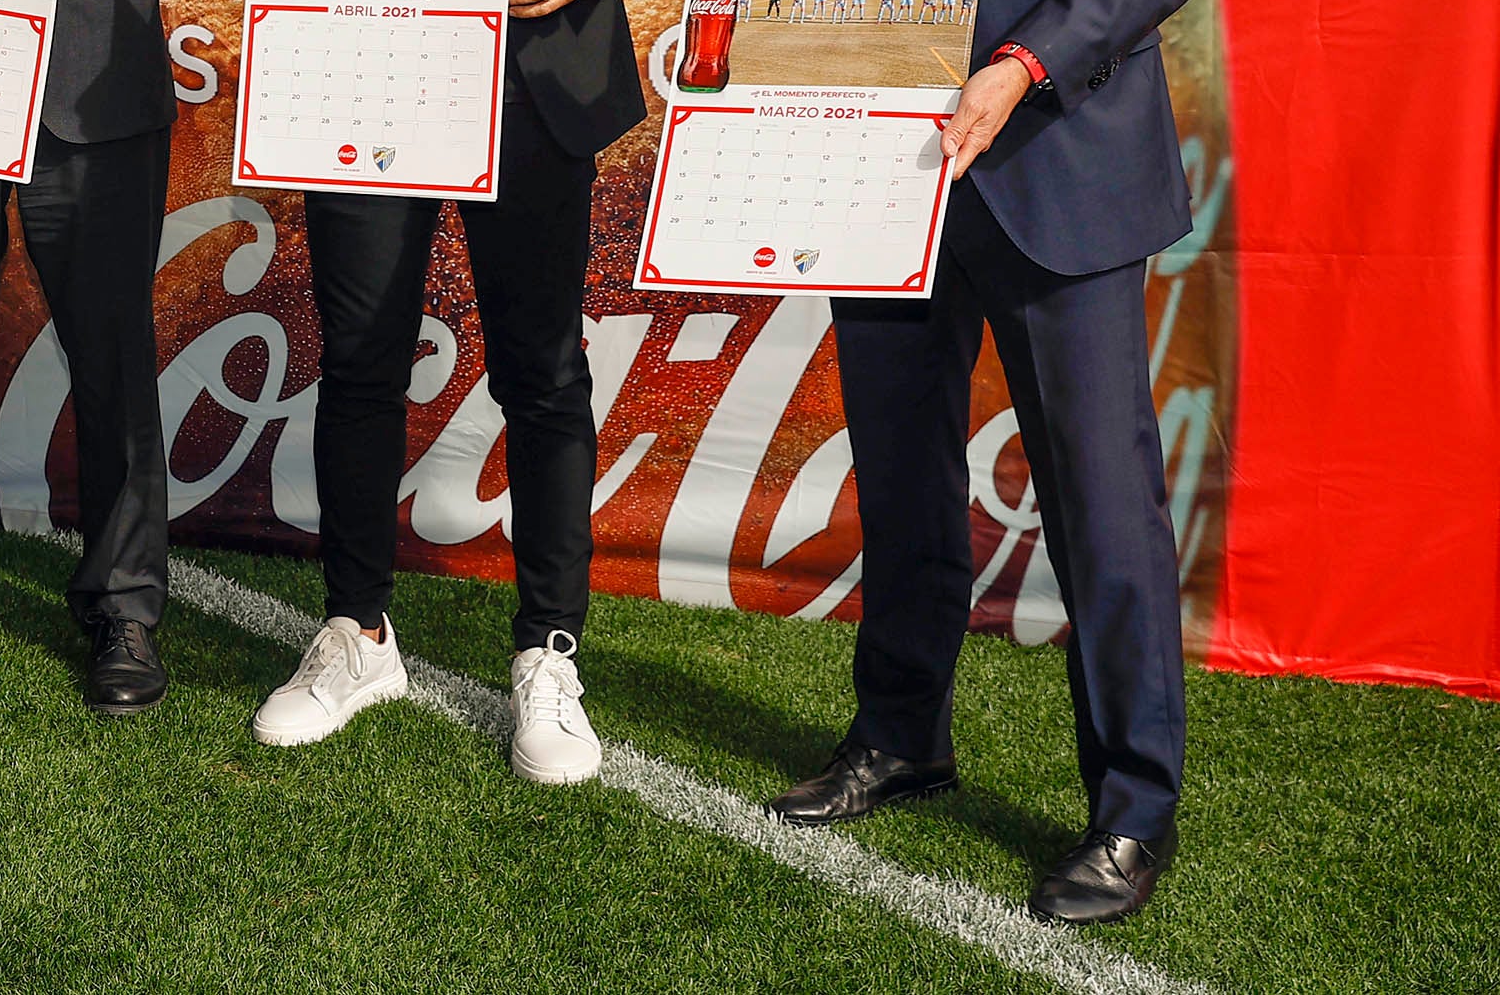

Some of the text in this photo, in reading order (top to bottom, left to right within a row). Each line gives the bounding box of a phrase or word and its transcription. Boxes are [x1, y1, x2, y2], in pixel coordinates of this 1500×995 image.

[333, 4, 416, 18] ABRIL 2021
[773, 90, 819, 98] MOMENTO
[820, 91, 866, 99] PERFECTO
[759, 106, 863, 119] MARZO 2021
